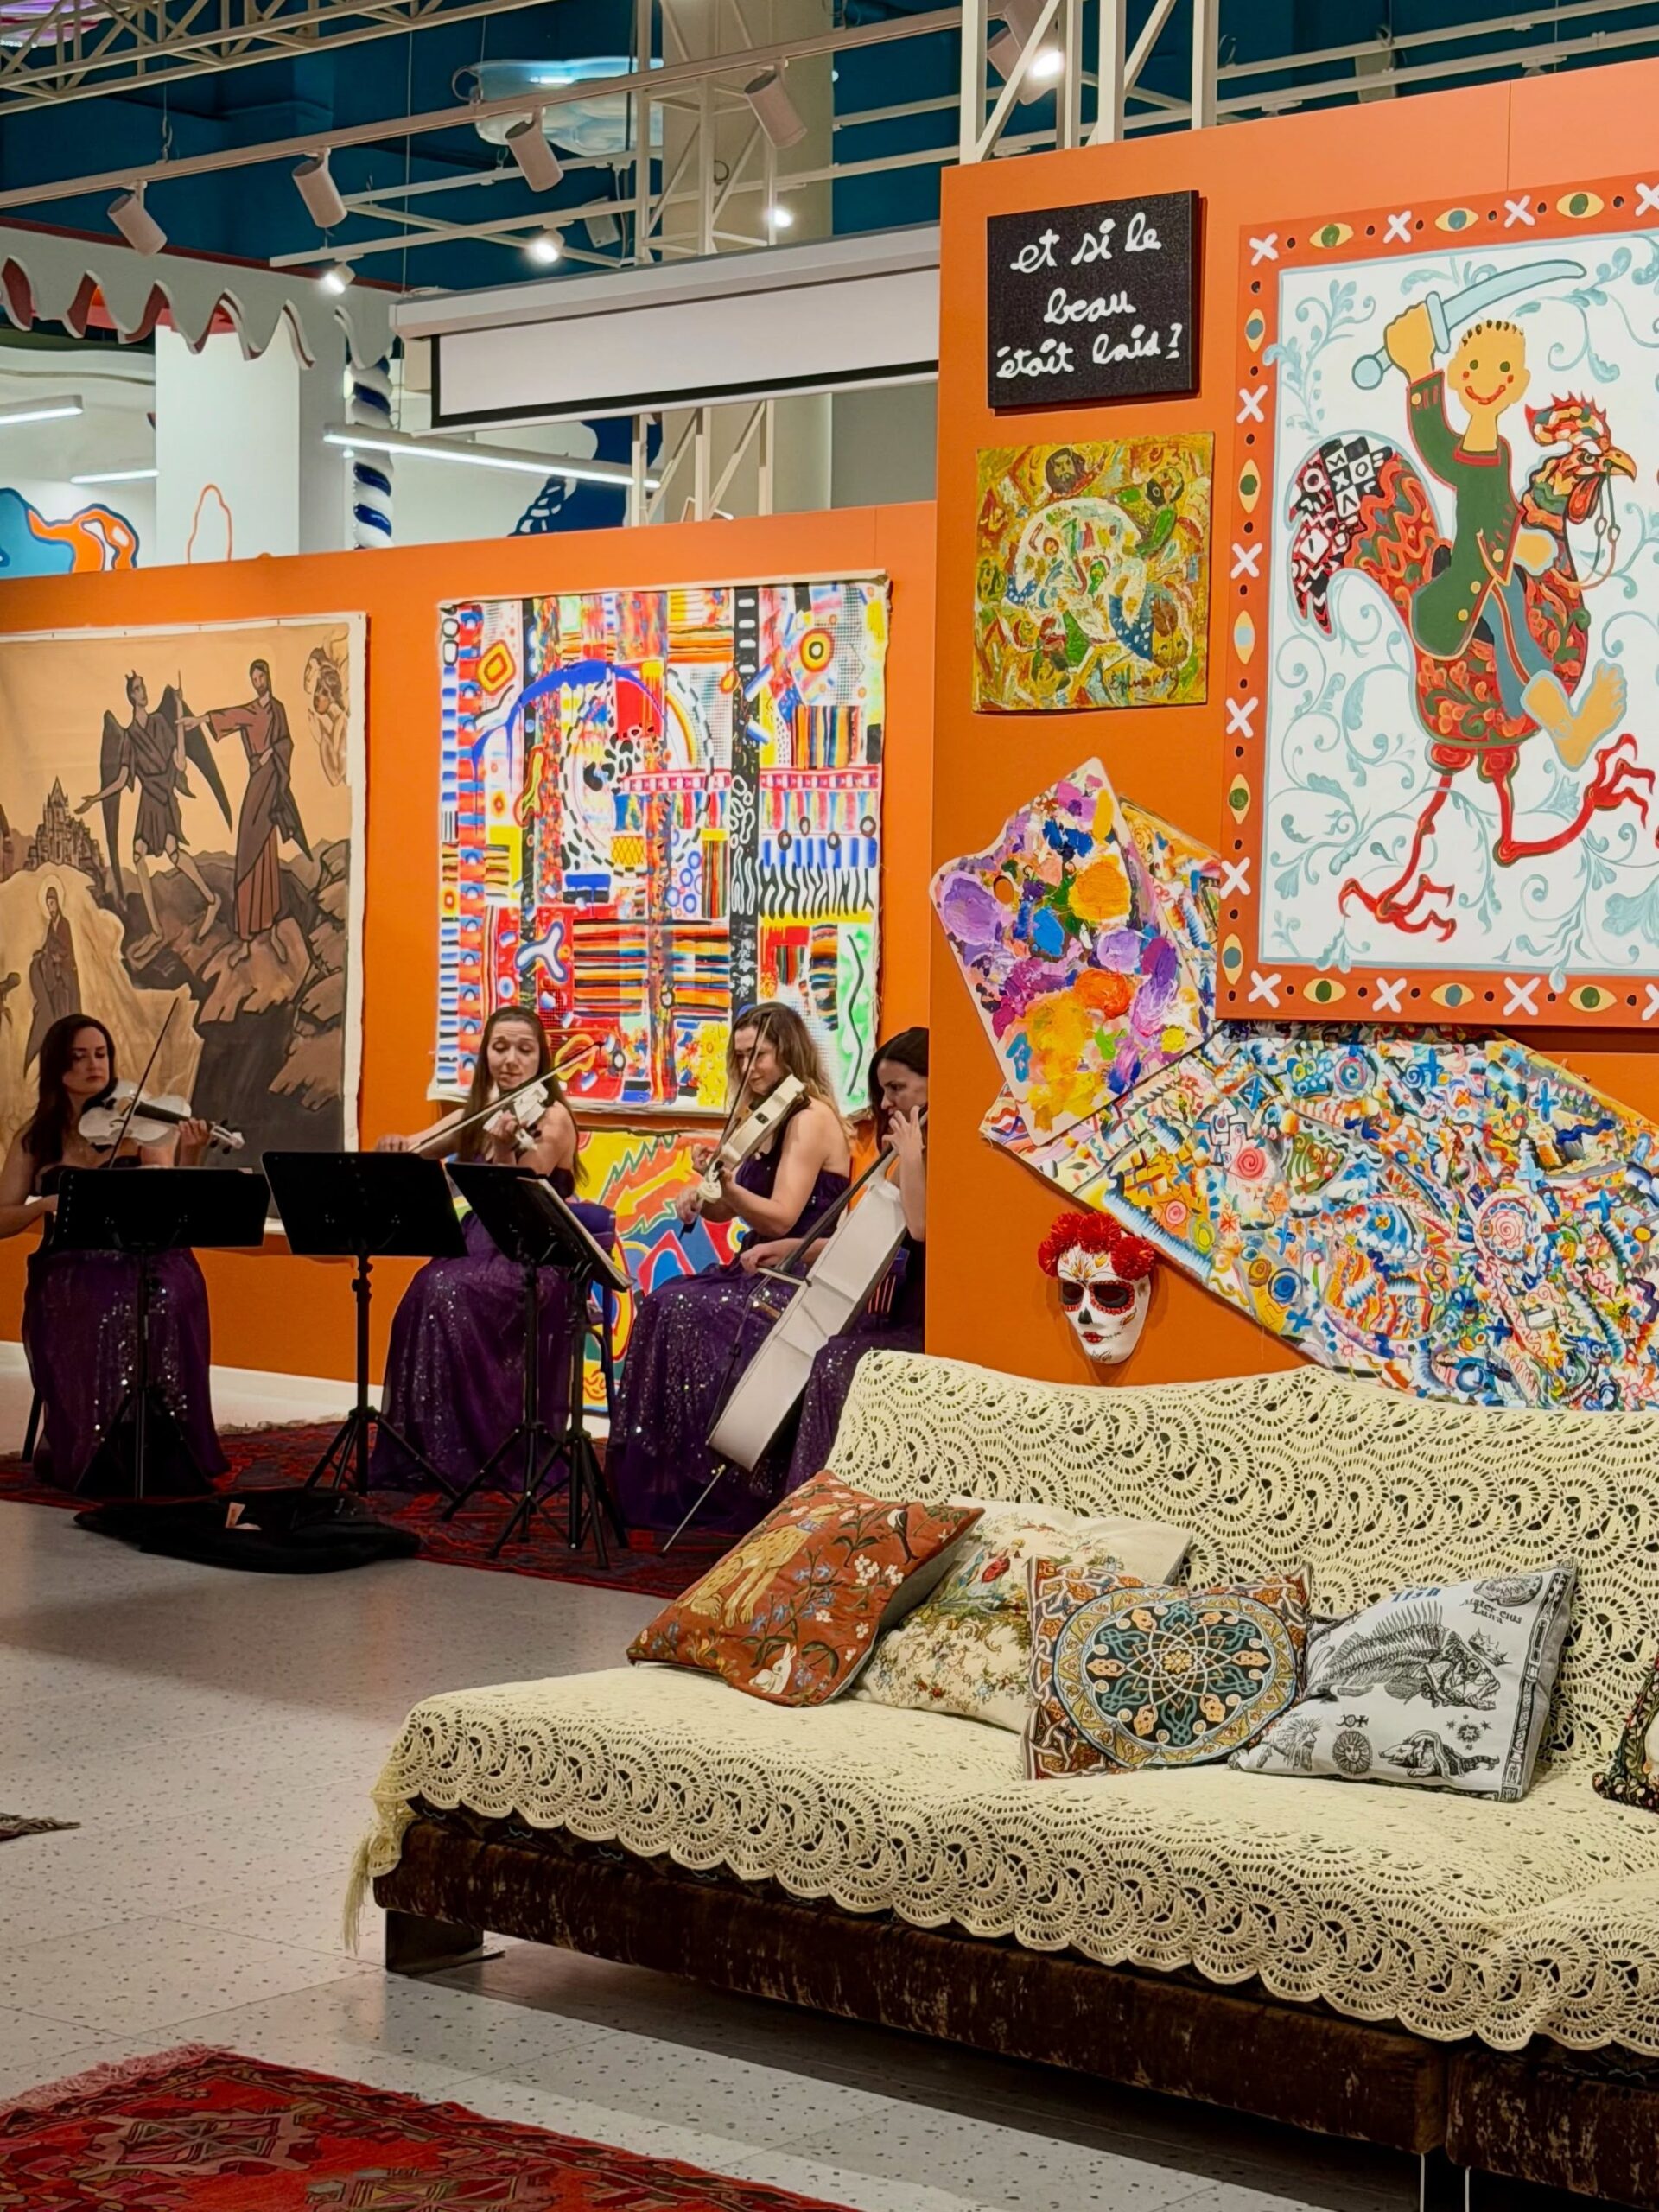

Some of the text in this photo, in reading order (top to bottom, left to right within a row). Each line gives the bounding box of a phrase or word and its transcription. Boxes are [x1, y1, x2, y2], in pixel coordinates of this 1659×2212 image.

[1010, 212, 1162, 273] et si le
[1043, 287, 1137, 325] beau
[996, 338, 1075, 379] était
